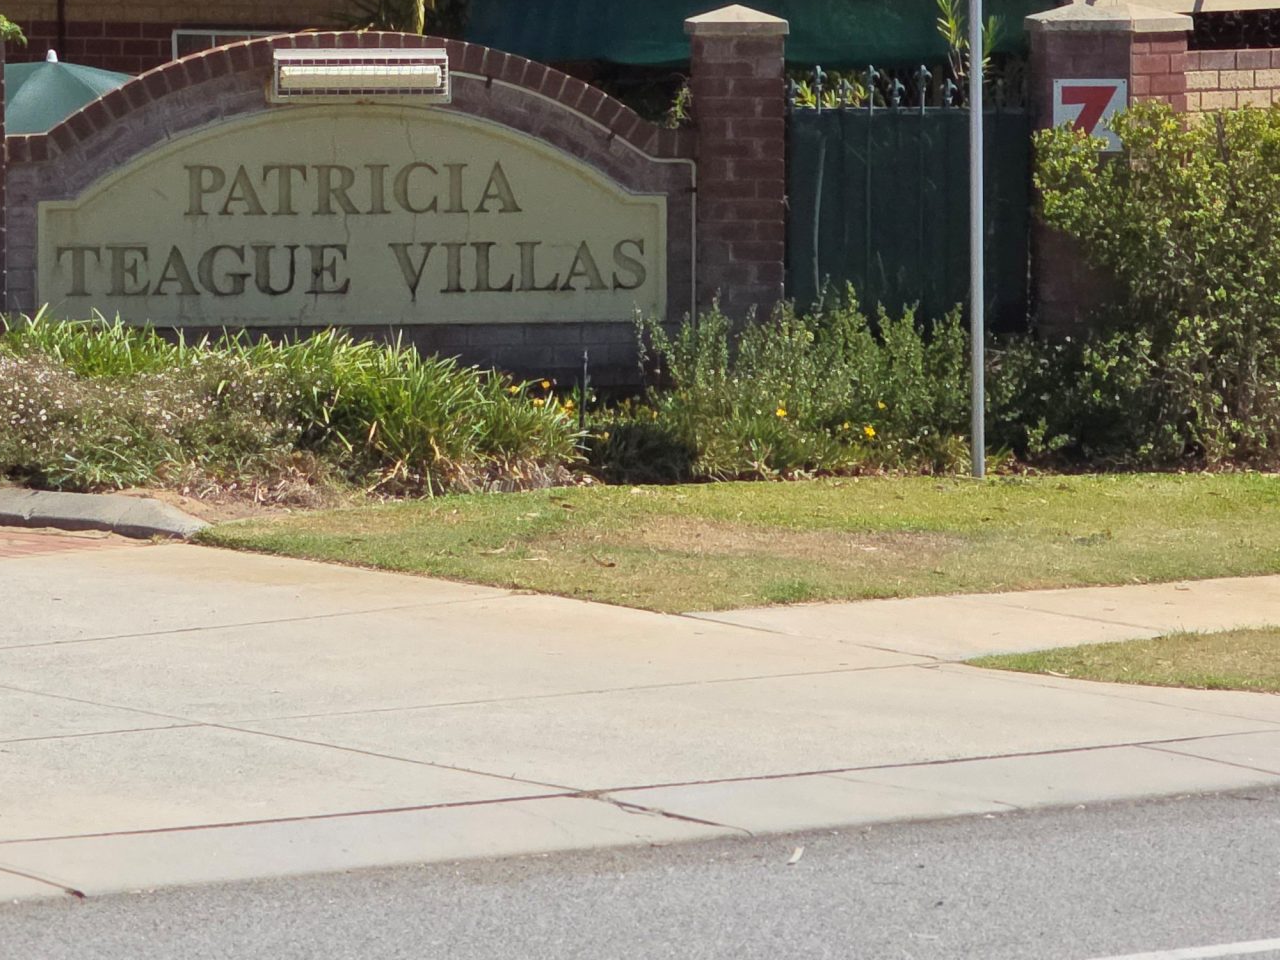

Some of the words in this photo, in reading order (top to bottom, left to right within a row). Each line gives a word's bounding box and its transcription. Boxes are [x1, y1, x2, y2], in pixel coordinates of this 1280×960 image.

[1061, 86, 1118, 139] 7
[183, 161, 522, 216] PATRICIA
[56, 243, 350, 297] TEAGUE
[388, 239, 647, 298] VILLAS
